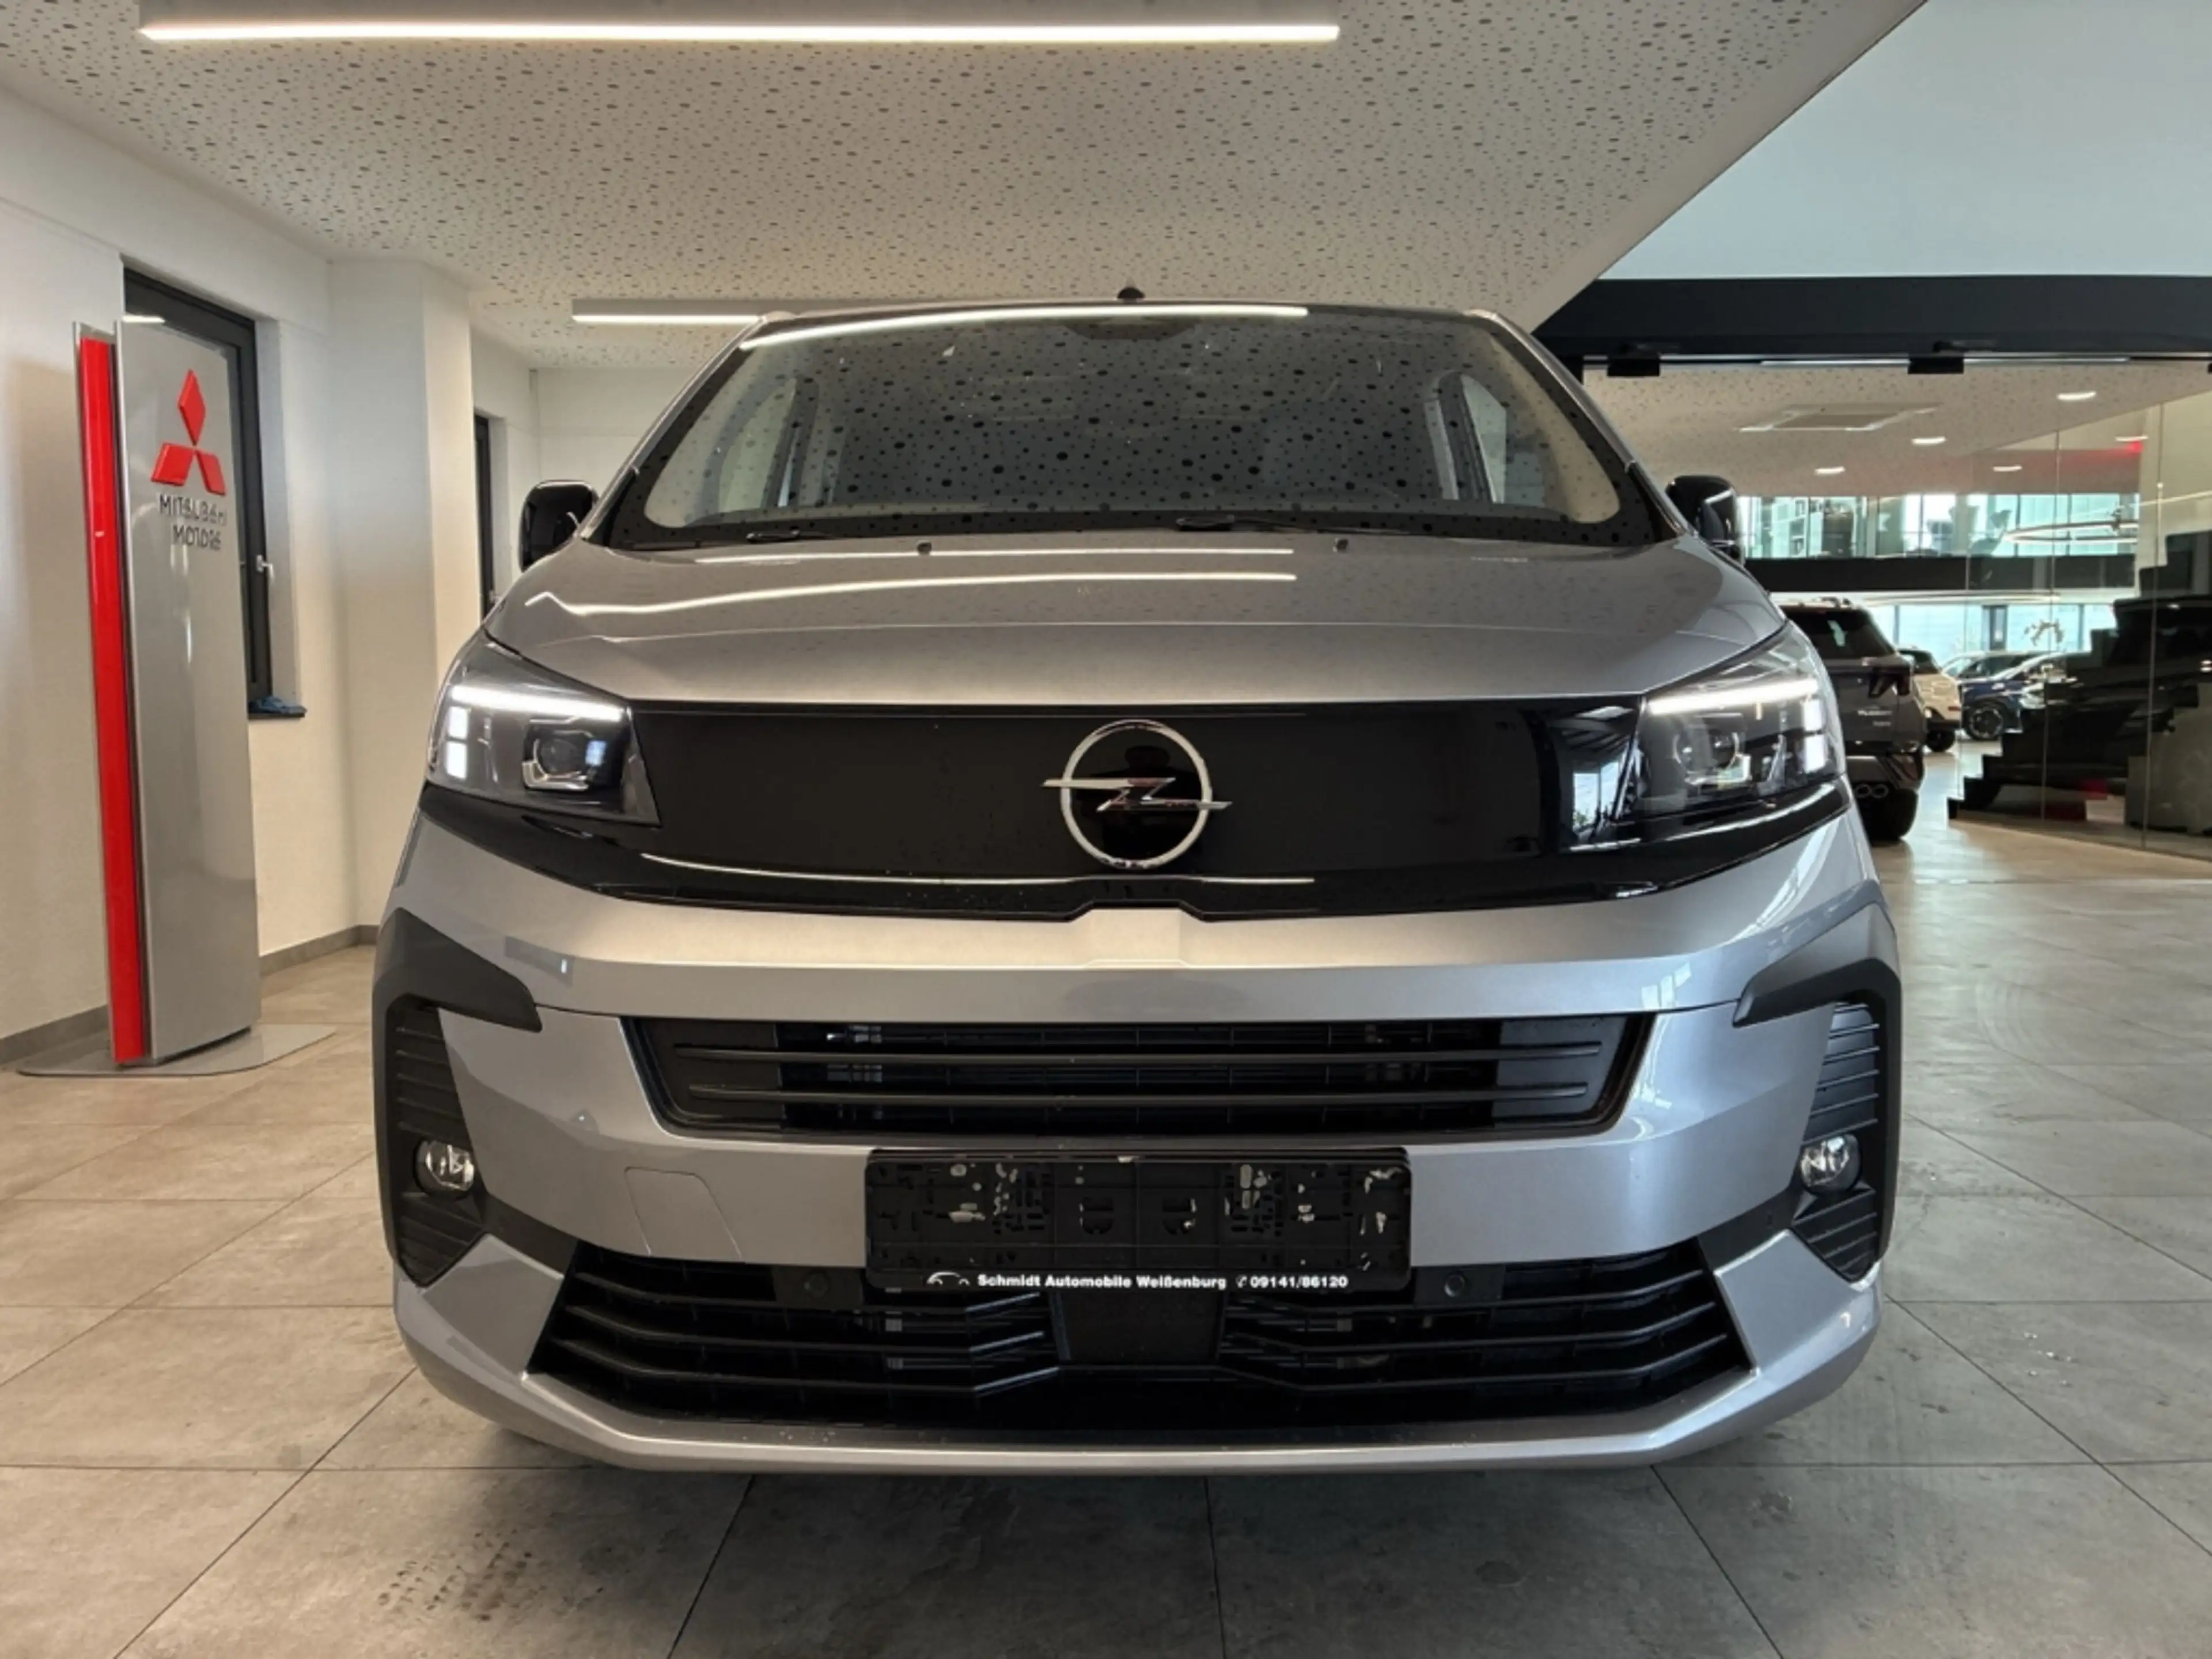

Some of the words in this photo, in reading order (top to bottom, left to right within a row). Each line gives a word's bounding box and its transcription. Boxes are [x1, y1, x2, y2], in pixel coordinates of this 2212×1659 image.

[978, 1274, 1040, 1287] Schmidt
[1045, 1274, 1132, 1287] Automobile
[1137, 1274, 1226, 1290] Weißenburg
[1249, 1274, 1349, 1289] 09141/86120
